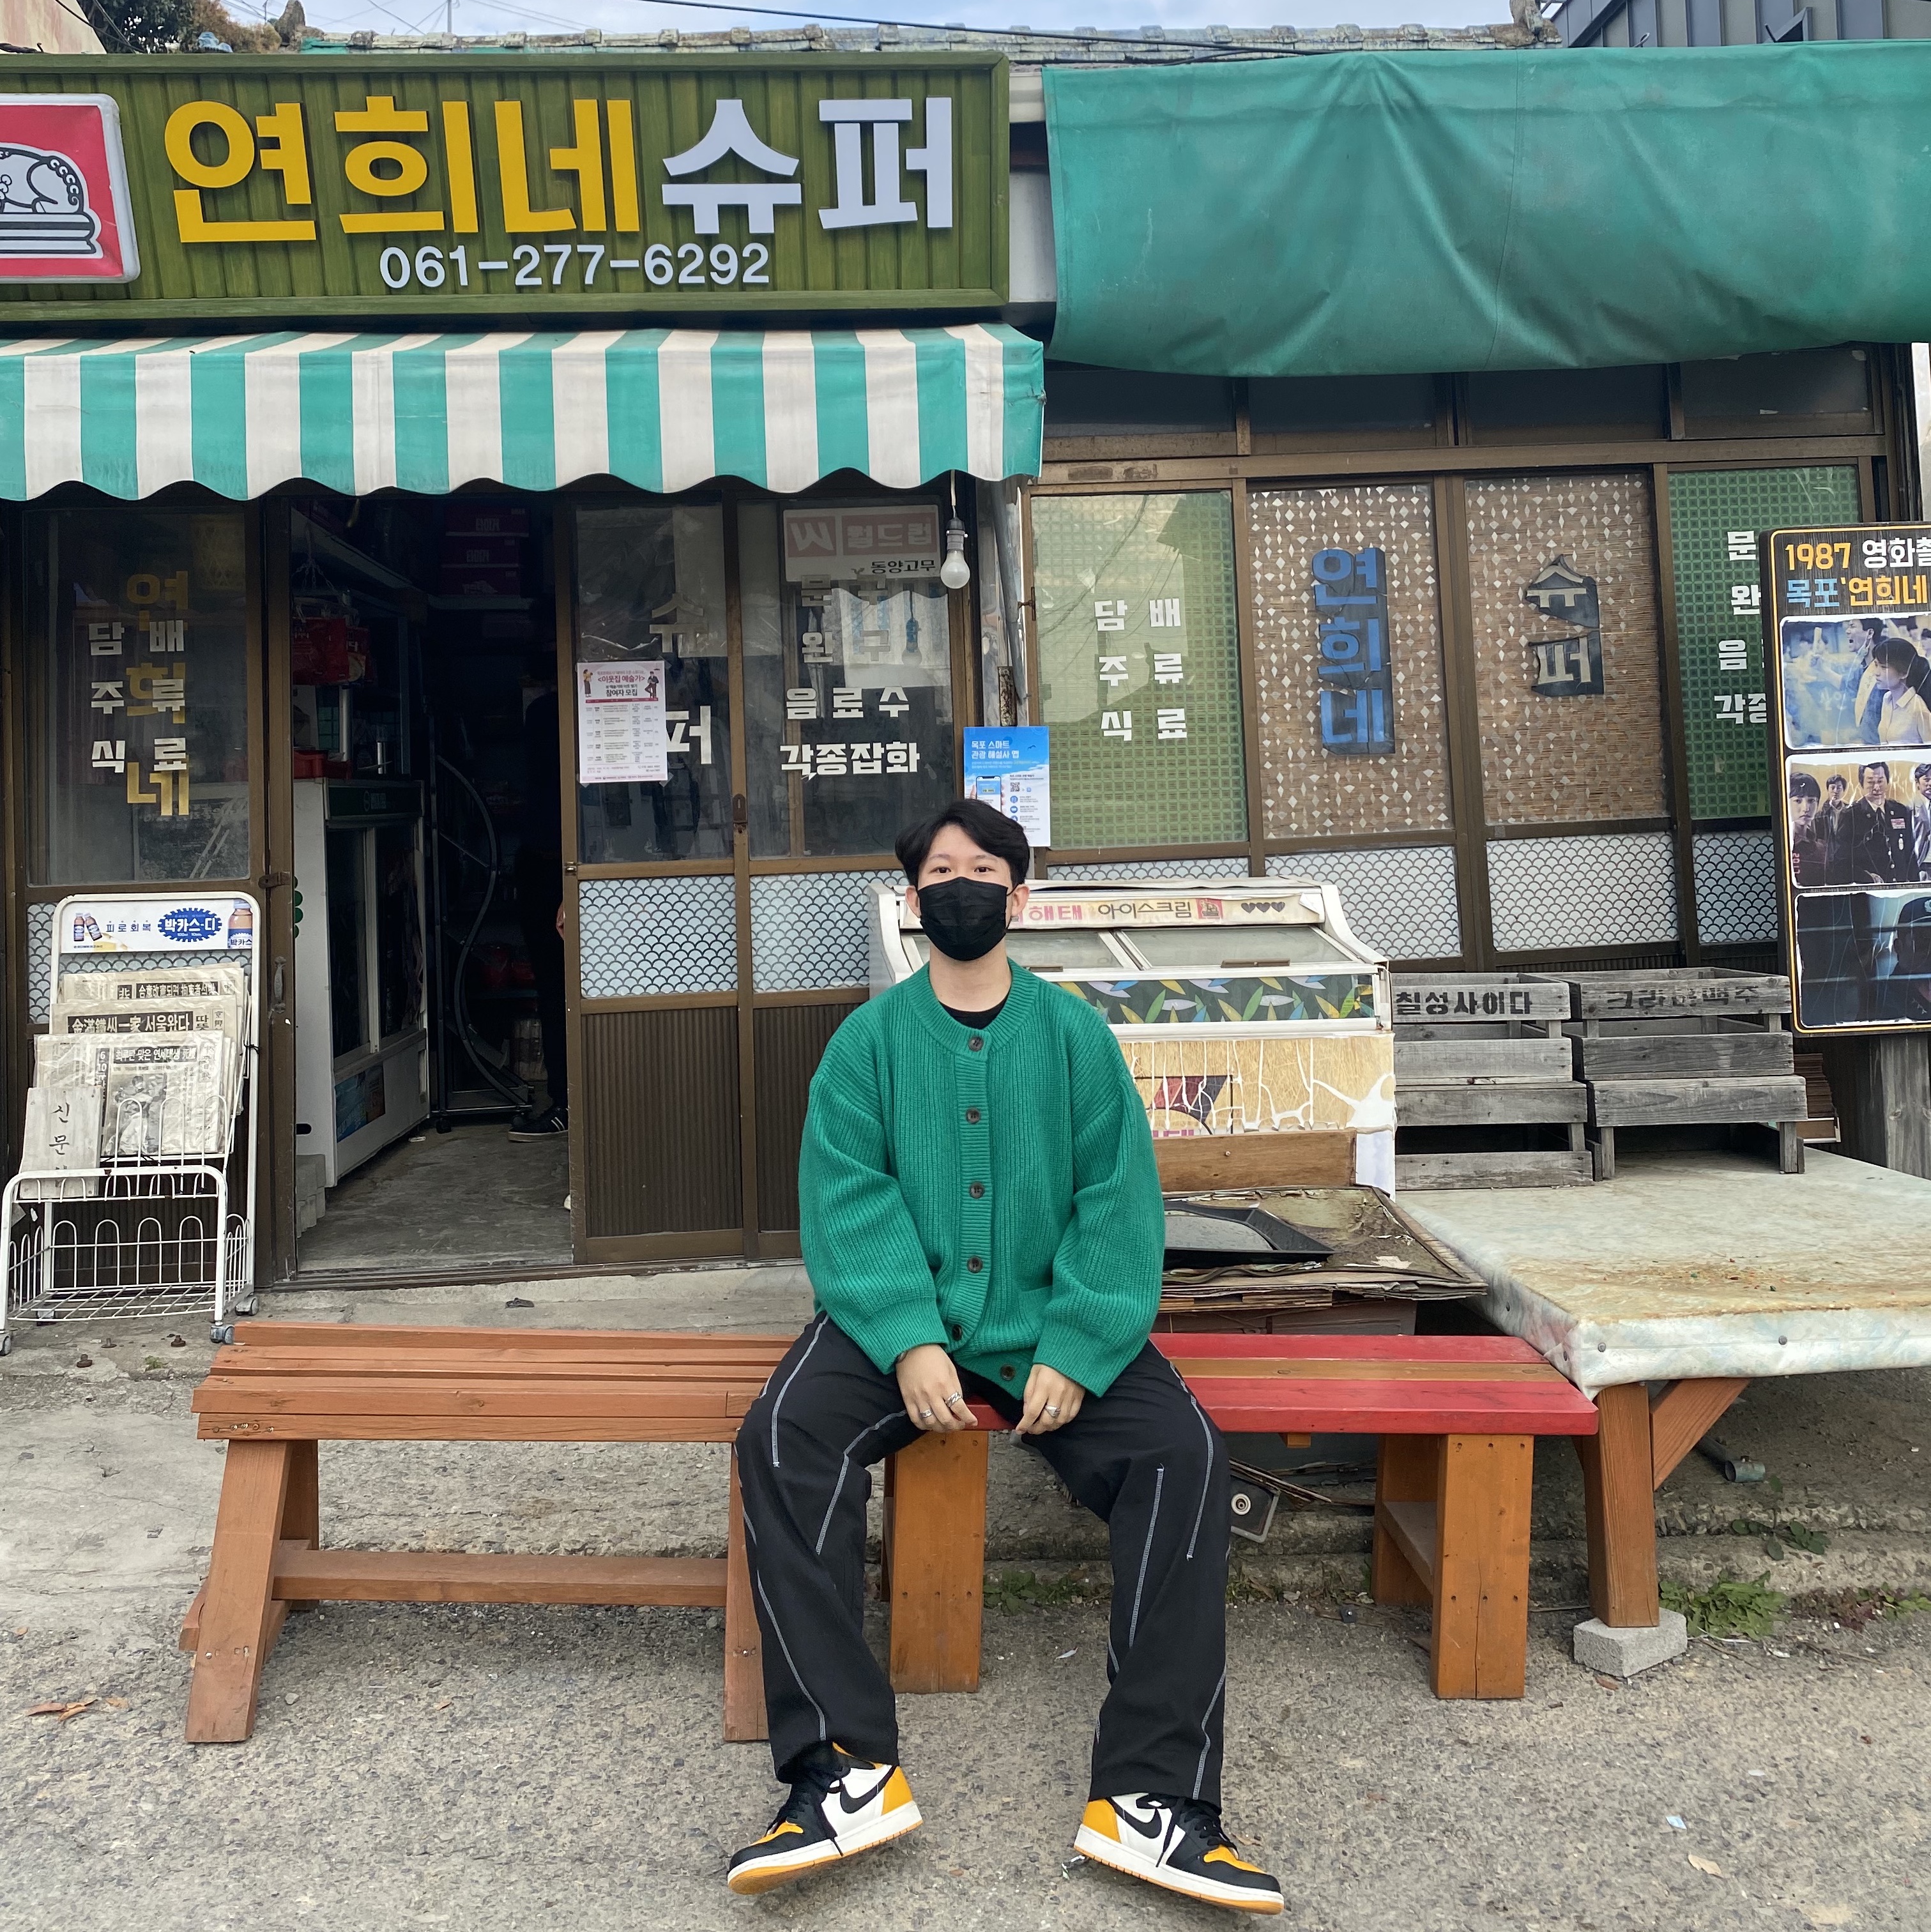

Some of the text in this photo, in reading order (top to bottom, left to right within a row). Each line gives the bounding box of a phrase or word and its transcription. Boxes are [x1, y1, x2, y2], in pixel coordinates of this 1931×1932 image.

[165, 96, 952, 243] 연희네 슈퍼
[379, 243, 769, 289] 061-277-6292
[847, 522, 931, 549] 월드컵
[871, 559, 936, 574] 동양고무
[1785, 542, 1851, 570] 1987
[1787, 578, 1840, 608] 목포
[1094, 598, 1182, 631] 담배
[1527, 561, 1592, 684] 슈퍼
[88, 620, 185, 655] 담배
[802, 630, 890, 663] 완구
[1312, 547, 1384, 743] 연희네
[597, 674, 645, 683] <이웃집 예술가>
[1099, 653, 1184, 687] 주류
[91, 678, 185, 714] 주류
[786, 687, 910, 720] 음료수
[1100, 708, 1187, 741] 식료
[91, 737, 187, 773] 식료
[780, 742, 920, 776] 각종잡화
[972, 750, 986, 759] 관광
[988, 750, 1010, 759] 해설사
[988, 740, 1010, 749] 스마트
[1028, 901, 1192, 920] 해태 아이스크림
[1396, 991, 1533, 1015] 칠성사이다
